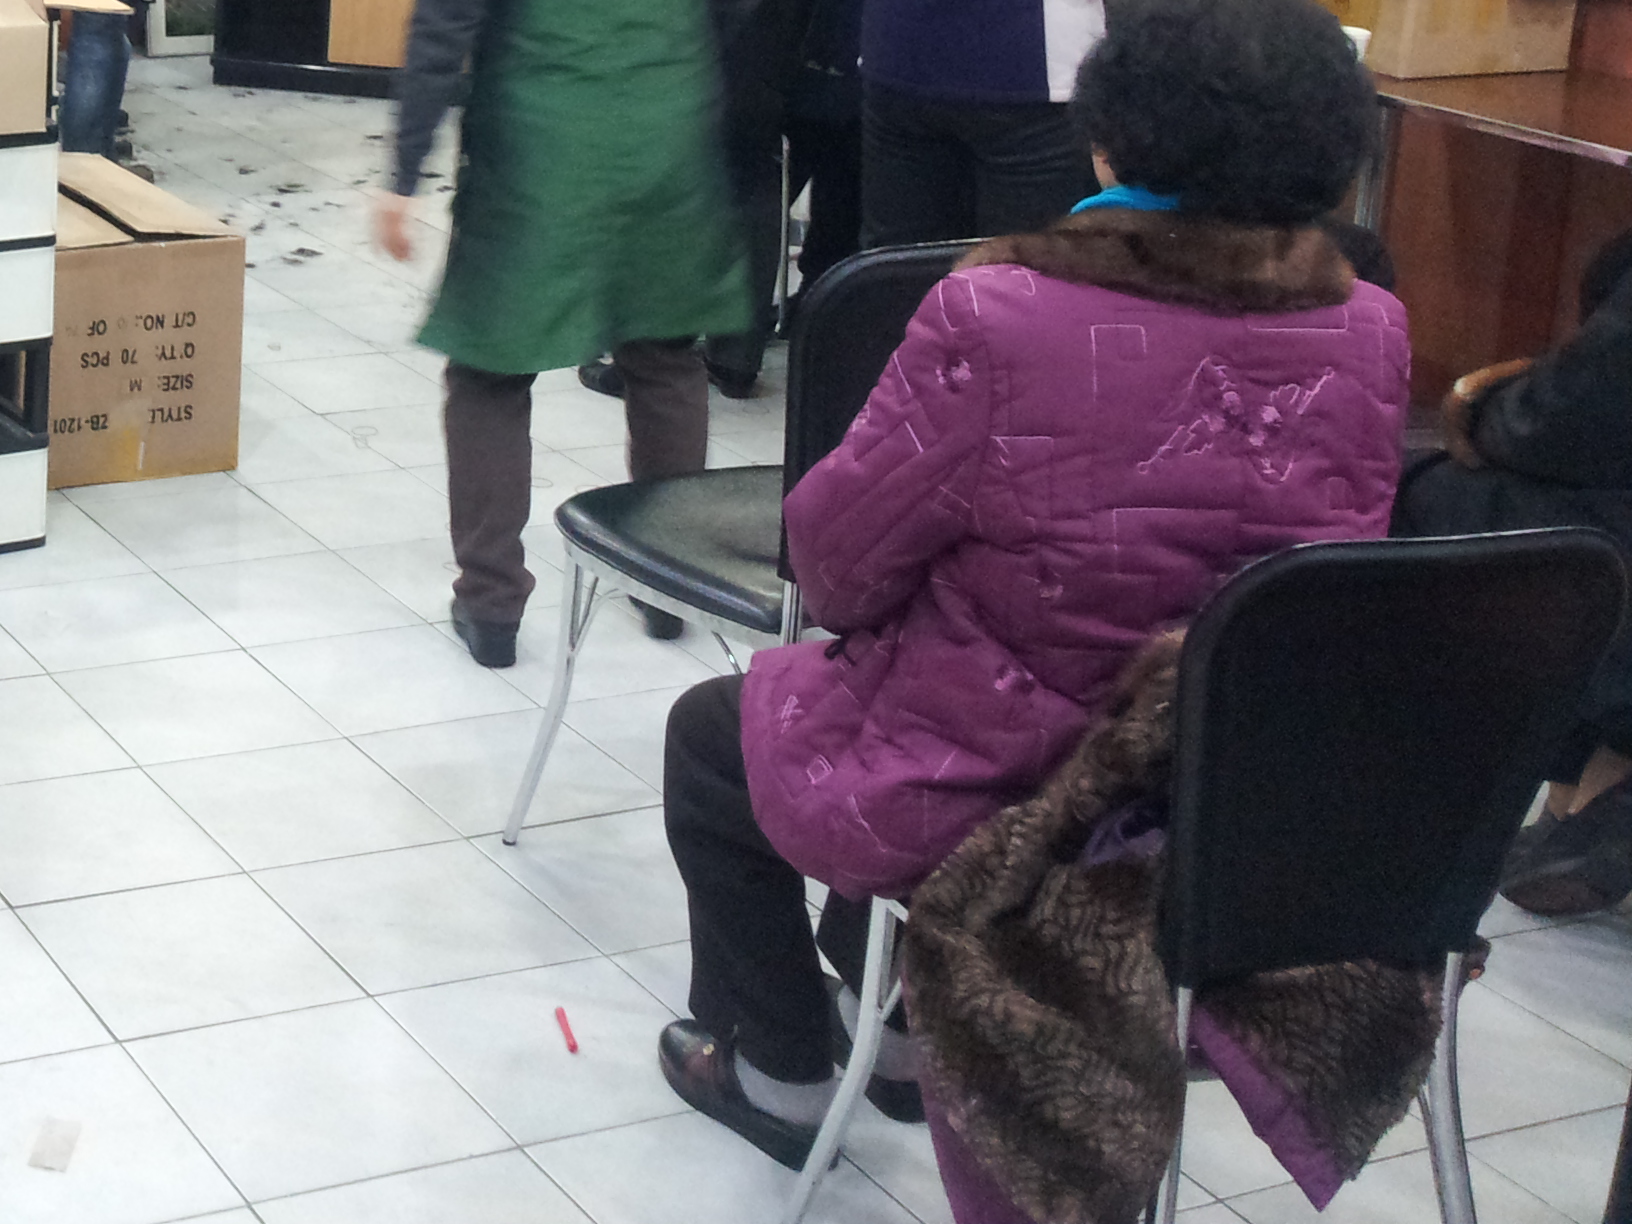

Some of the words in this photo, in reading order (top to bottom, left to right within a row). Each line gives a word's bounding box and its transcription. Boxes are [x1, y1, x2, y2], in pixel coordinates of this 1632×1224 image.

[87, 319, 107, 336] OF
[80, 351, 110, 369] PCS
[121, 348, 138, 364] 70
[129, 378, 142, 392] M
